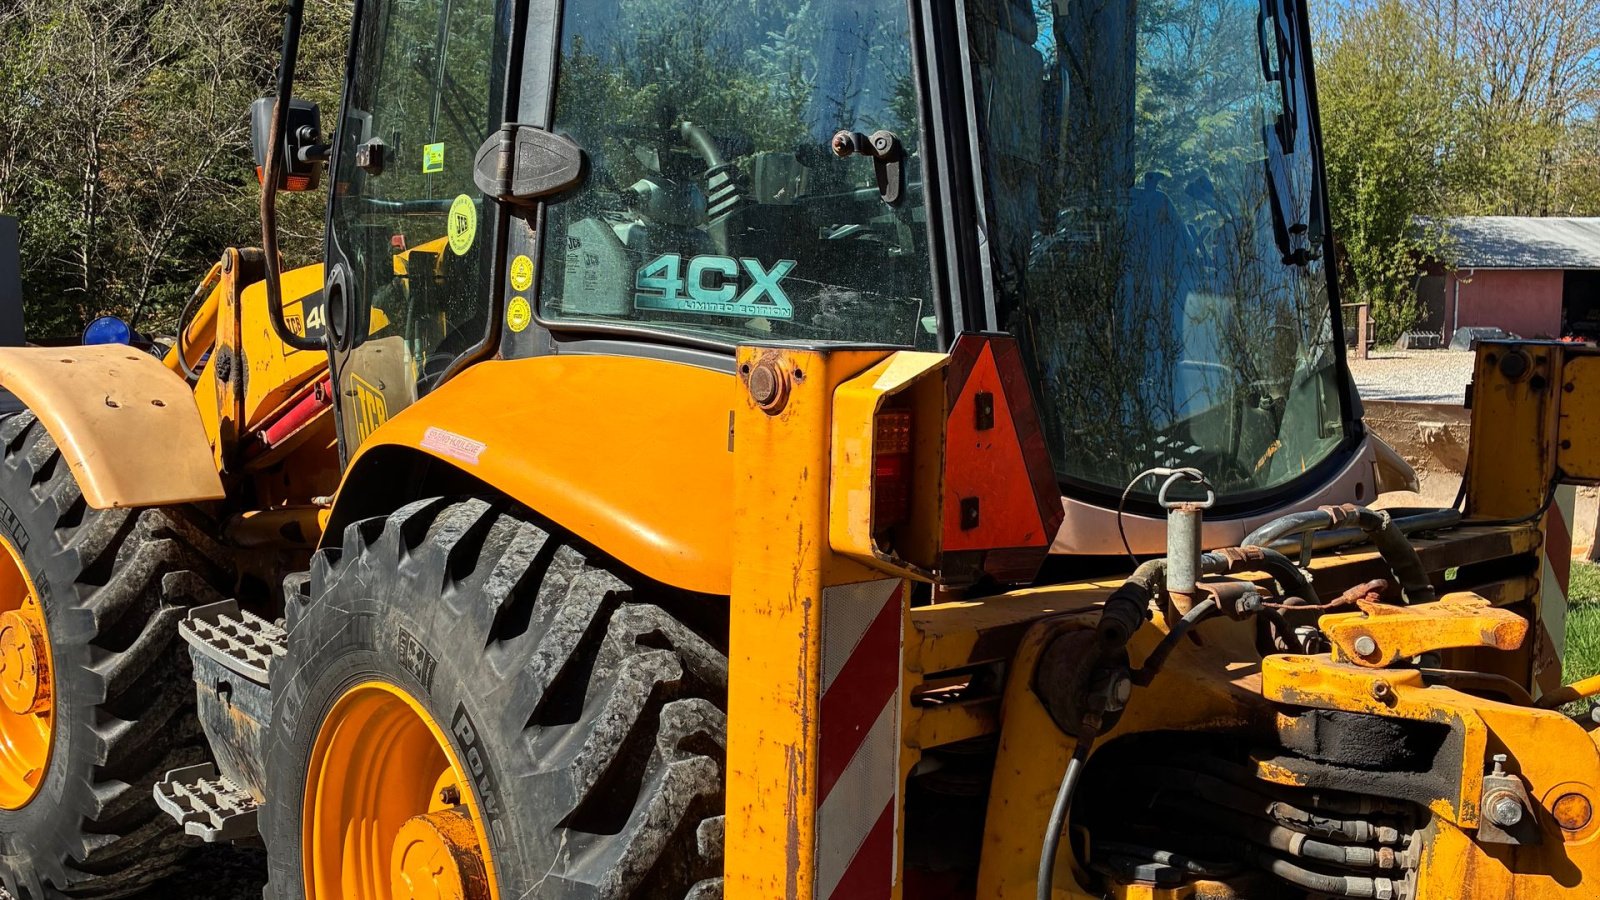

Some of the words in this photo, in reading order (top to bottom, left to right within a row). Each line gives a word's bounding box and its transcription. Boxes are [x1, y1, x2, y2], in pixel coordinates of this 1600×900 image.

[457, 215, 468, 234] JCB
[568, 238, 582, 250] JCB
[636, 252, 798, 308] 4CX
[684, 300, 735, 313] LIMITED
[739, 305, 791, 317] EDITION
